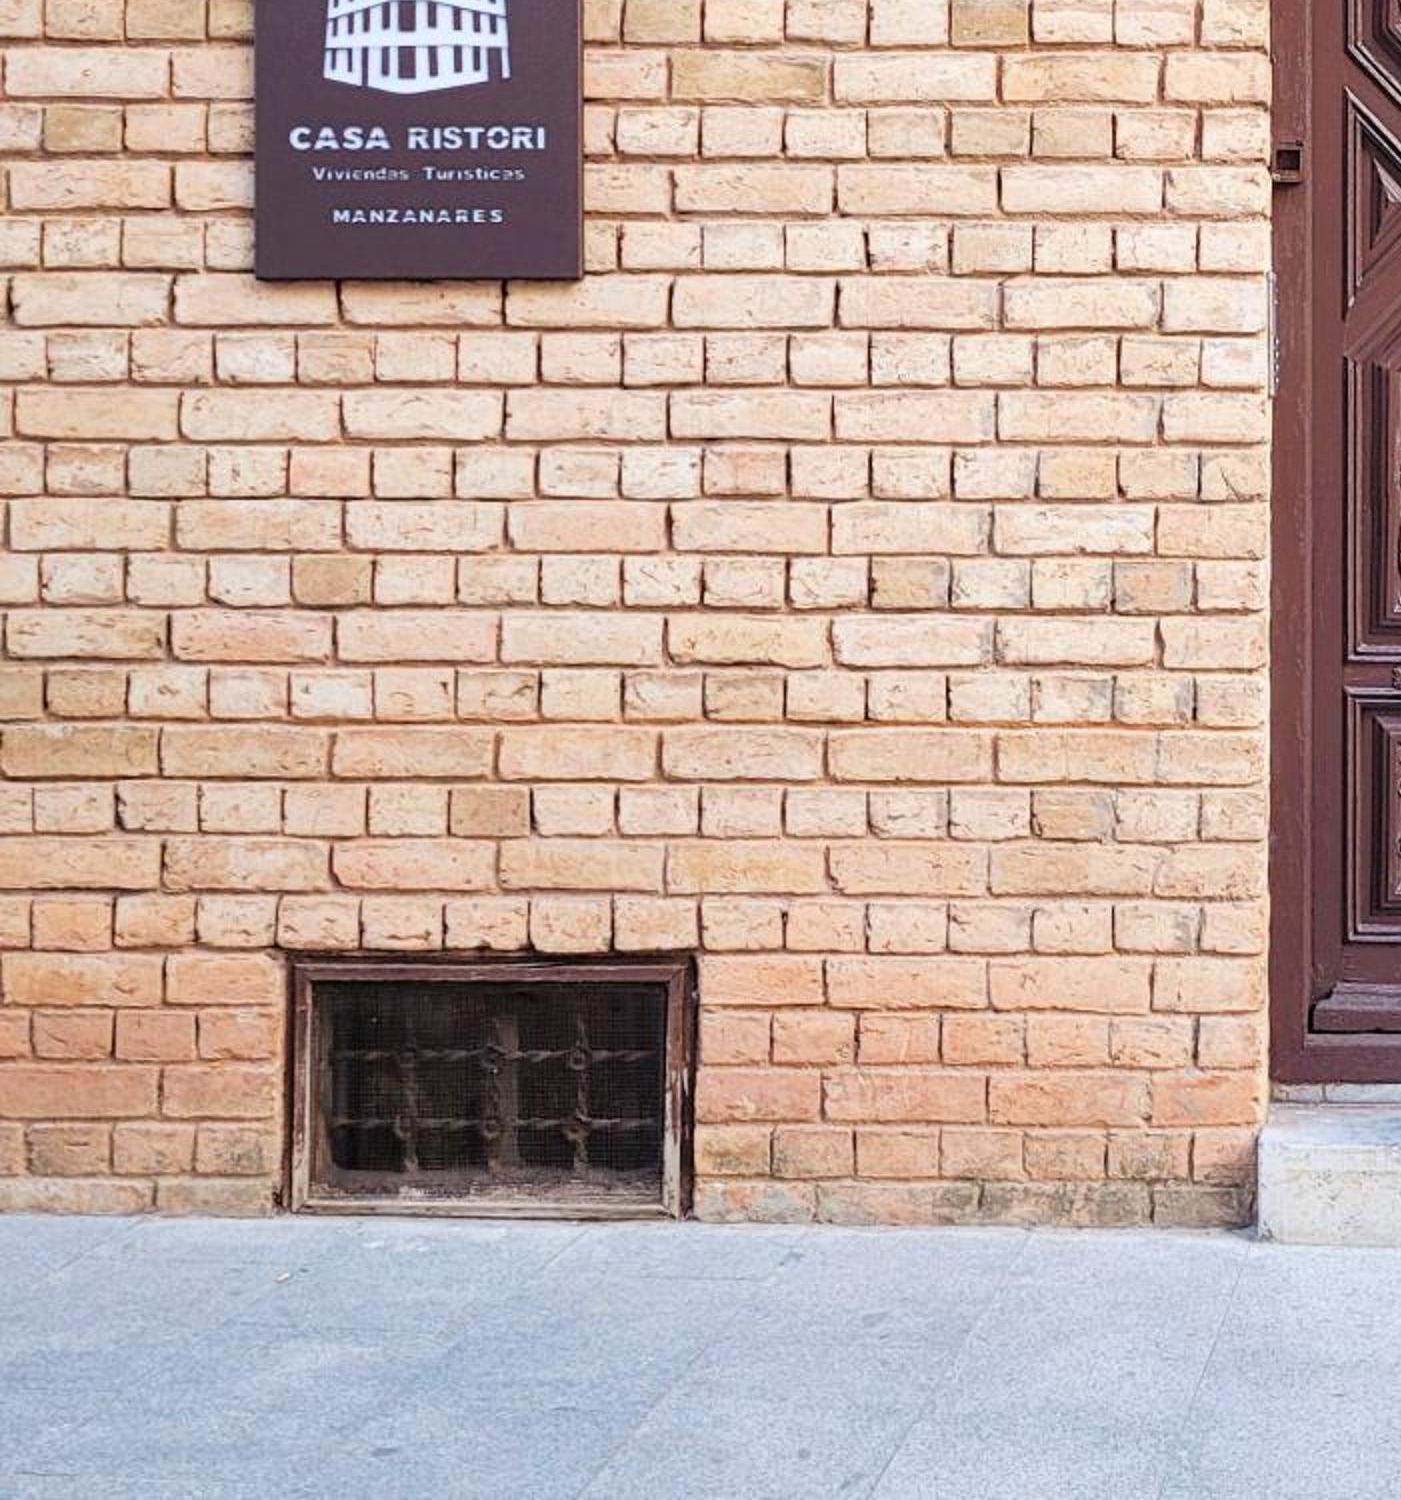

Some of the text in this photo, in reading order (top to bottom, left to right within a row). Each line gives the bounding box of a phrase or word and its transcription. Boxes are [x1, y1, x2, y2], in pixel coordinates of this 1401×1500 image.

[288, 126, 546, 151] CASA RISTORI
[312, 166, 409, 182] Viviendas
[333, 209, 504, 224] MANZANARES
